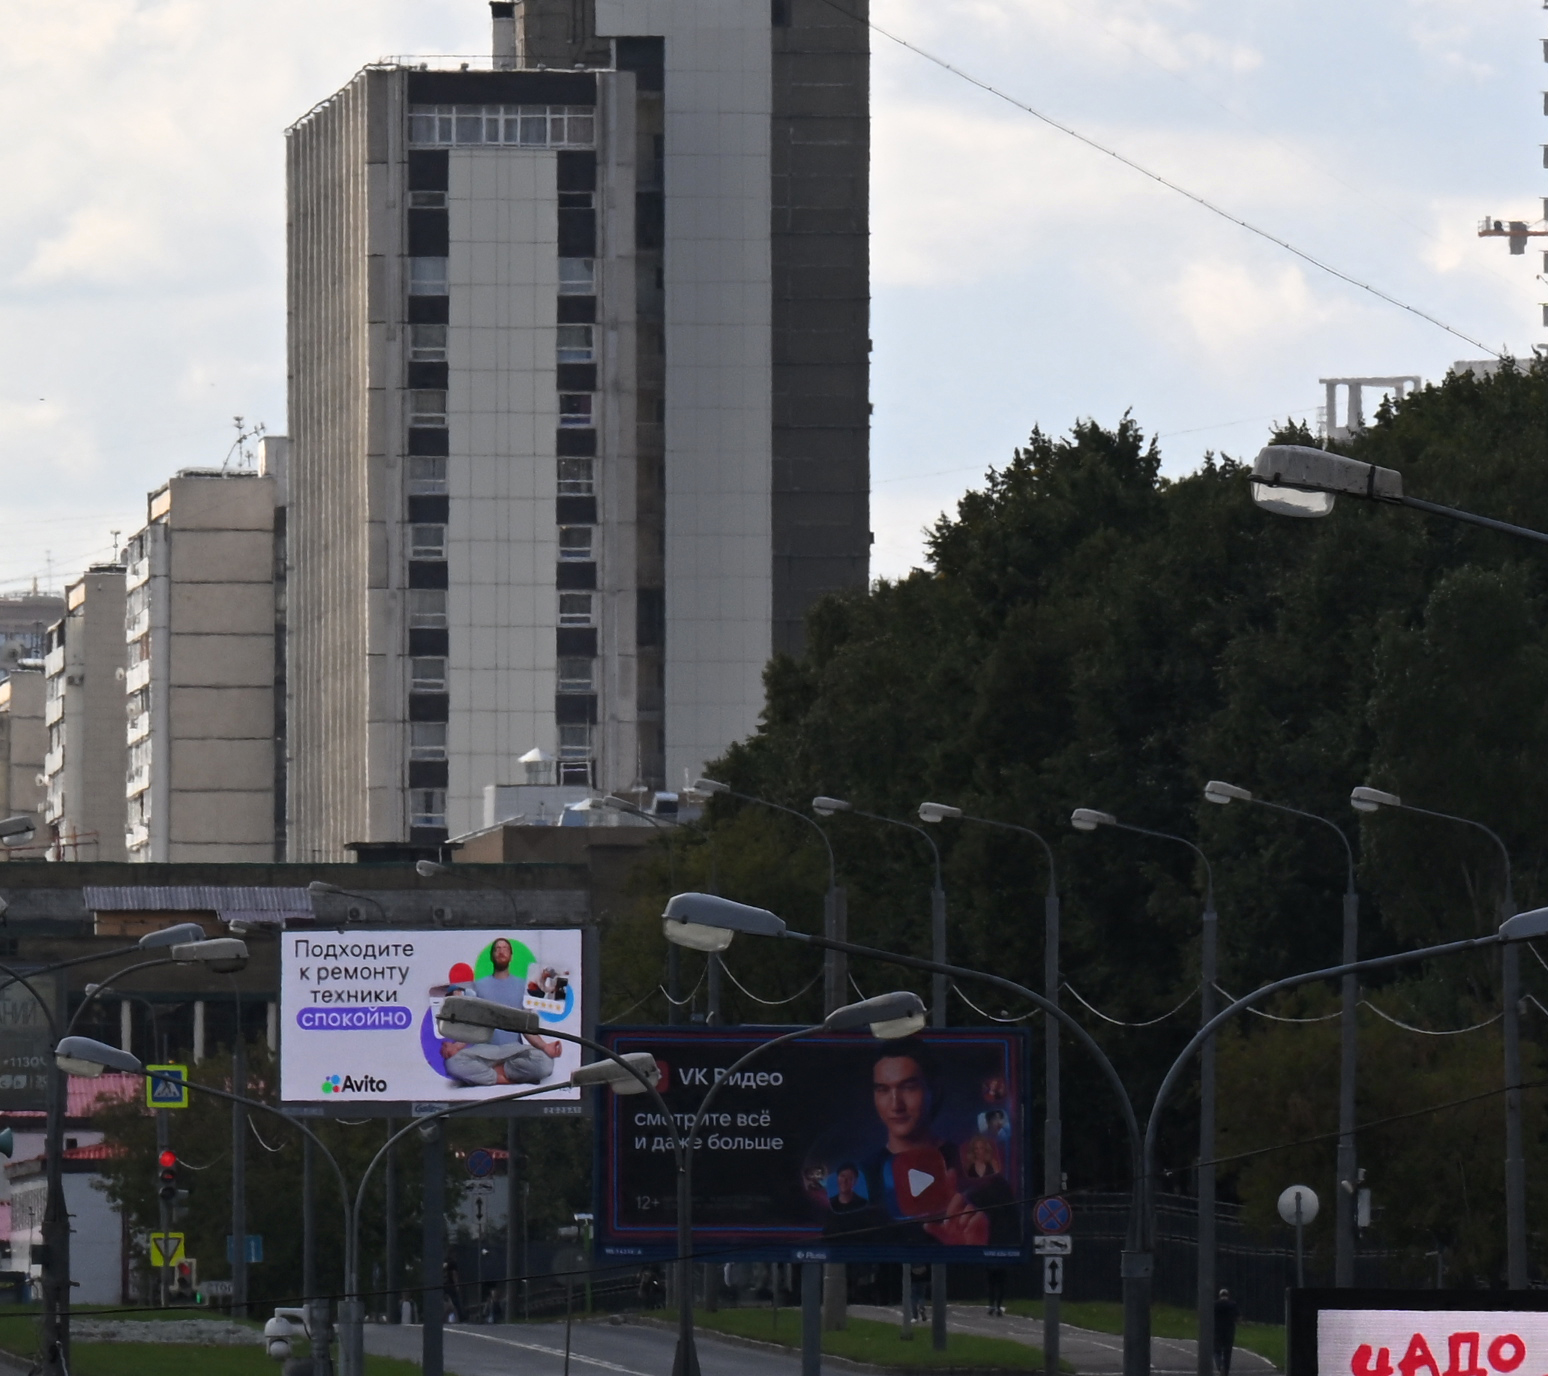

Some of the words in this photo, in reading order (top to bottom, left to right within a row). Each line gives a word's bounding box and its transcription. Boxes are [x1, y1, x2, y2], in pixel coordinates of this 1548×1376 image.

[294, 939, 414, 960] Подходите
[300, 966, 310, 980] к
[317, 965, 409, 985] ремонту
[310, 989, 398, 1003] техники
[302, 1007, 407, 1027] спокойно
[341, 1075, 387, 1093] Avito
[678, 1068, 708, 1086] VK
[737, 1110, 771, 1127] всё
[634, 1136, 647, 1150] и
[707, 1133, 784, 1151] больше
[636, 1195, 661, 1210] 12+
